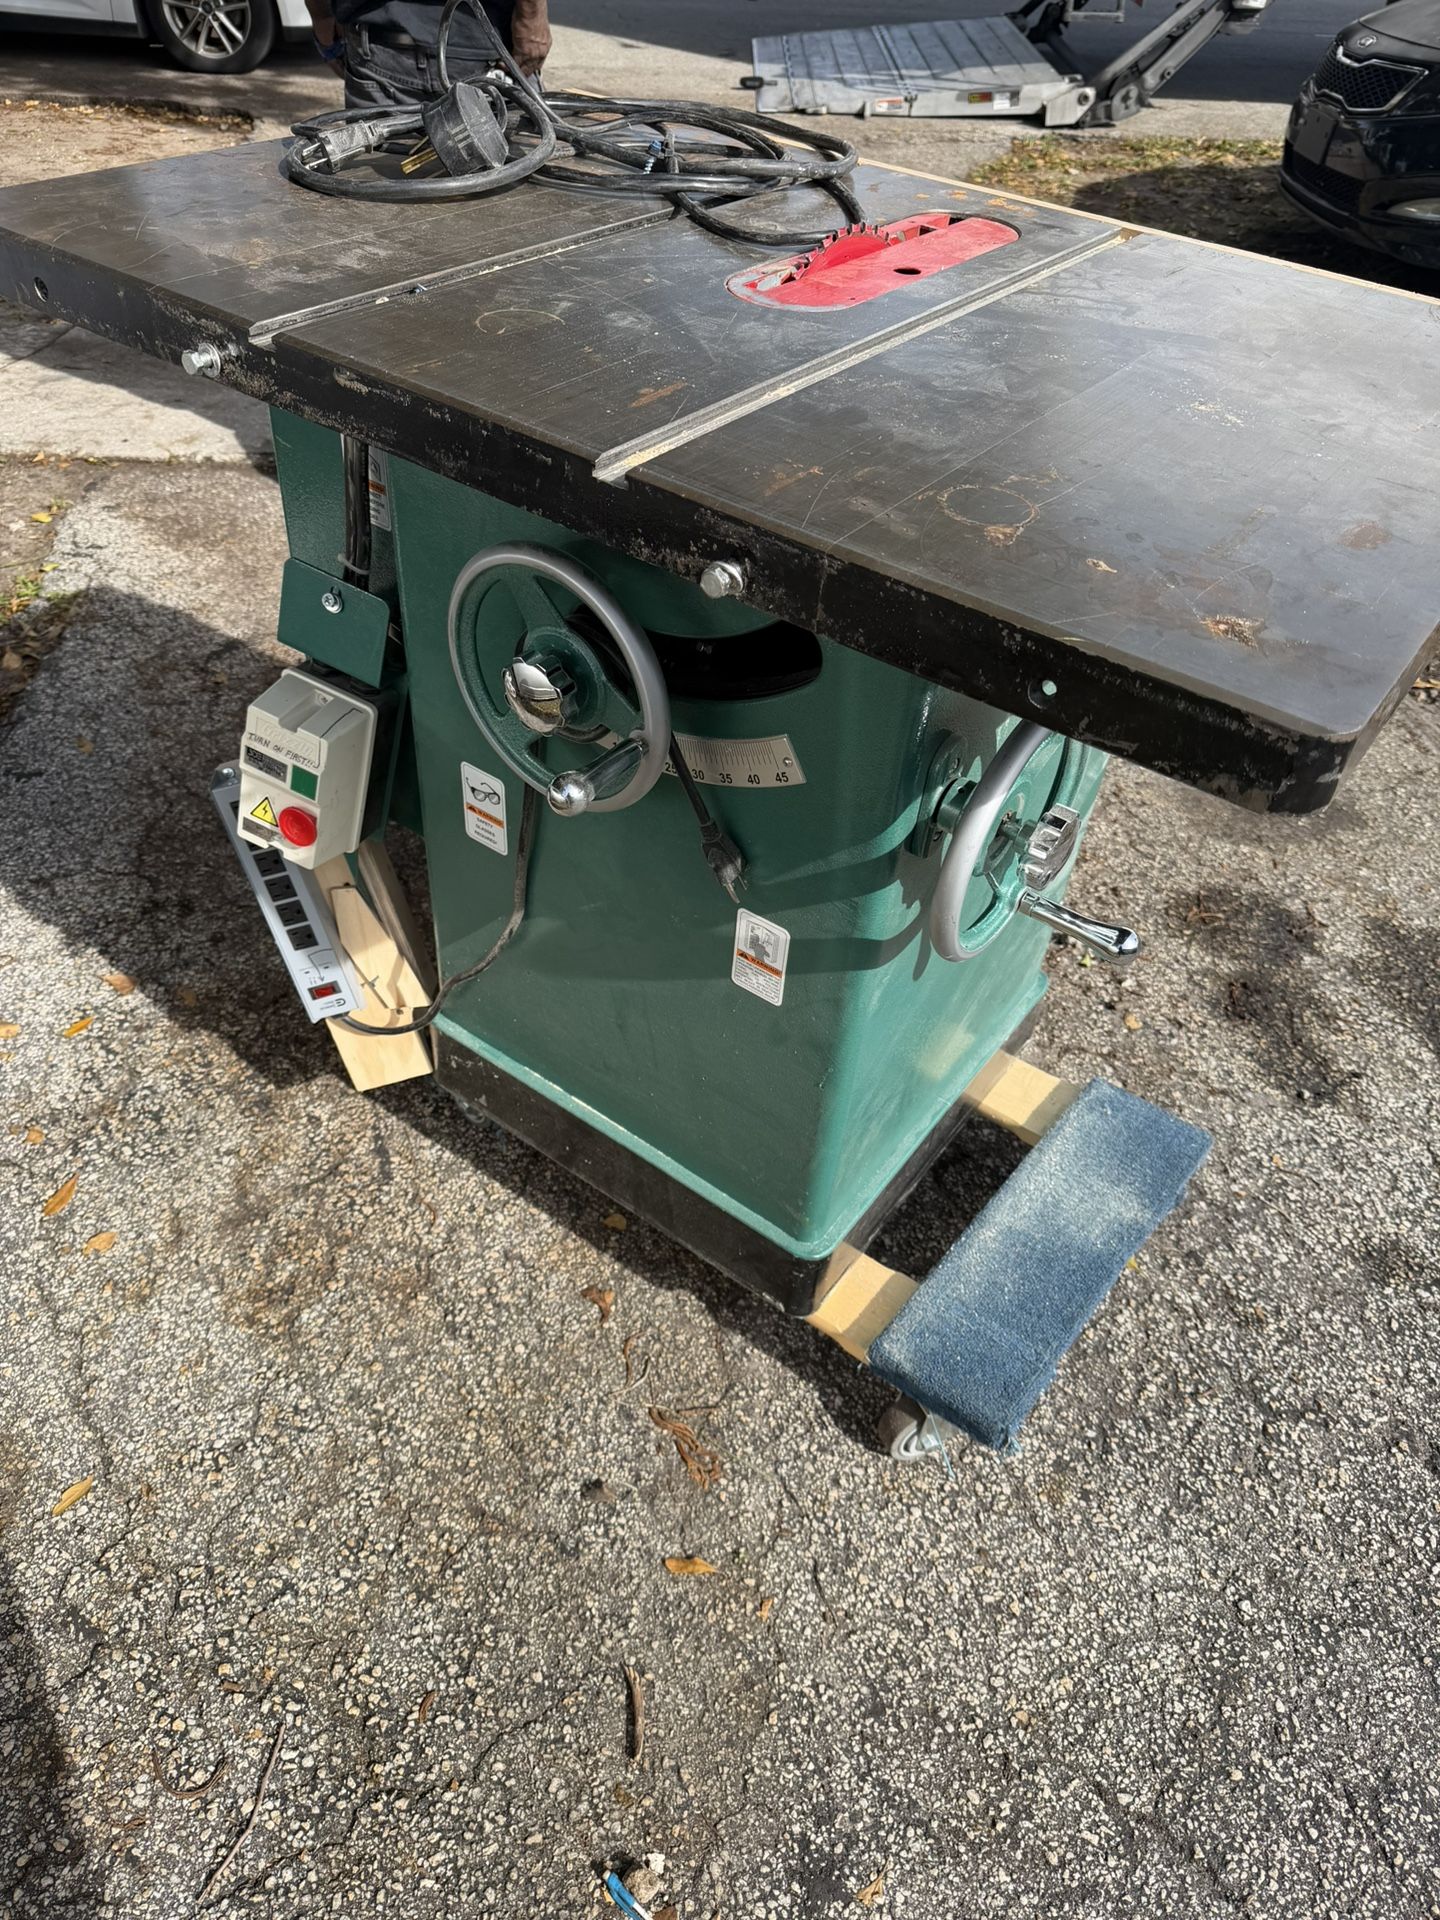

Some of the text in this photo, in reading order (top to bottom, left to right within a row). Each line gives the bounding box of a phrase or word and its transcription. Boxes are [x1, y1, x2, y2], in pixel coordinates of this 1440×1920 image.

[248, 733, 271, 748] TURN
[273, 745, 283, 753] ON
[664, 762, 789, 785] 25 30 35 40 45
